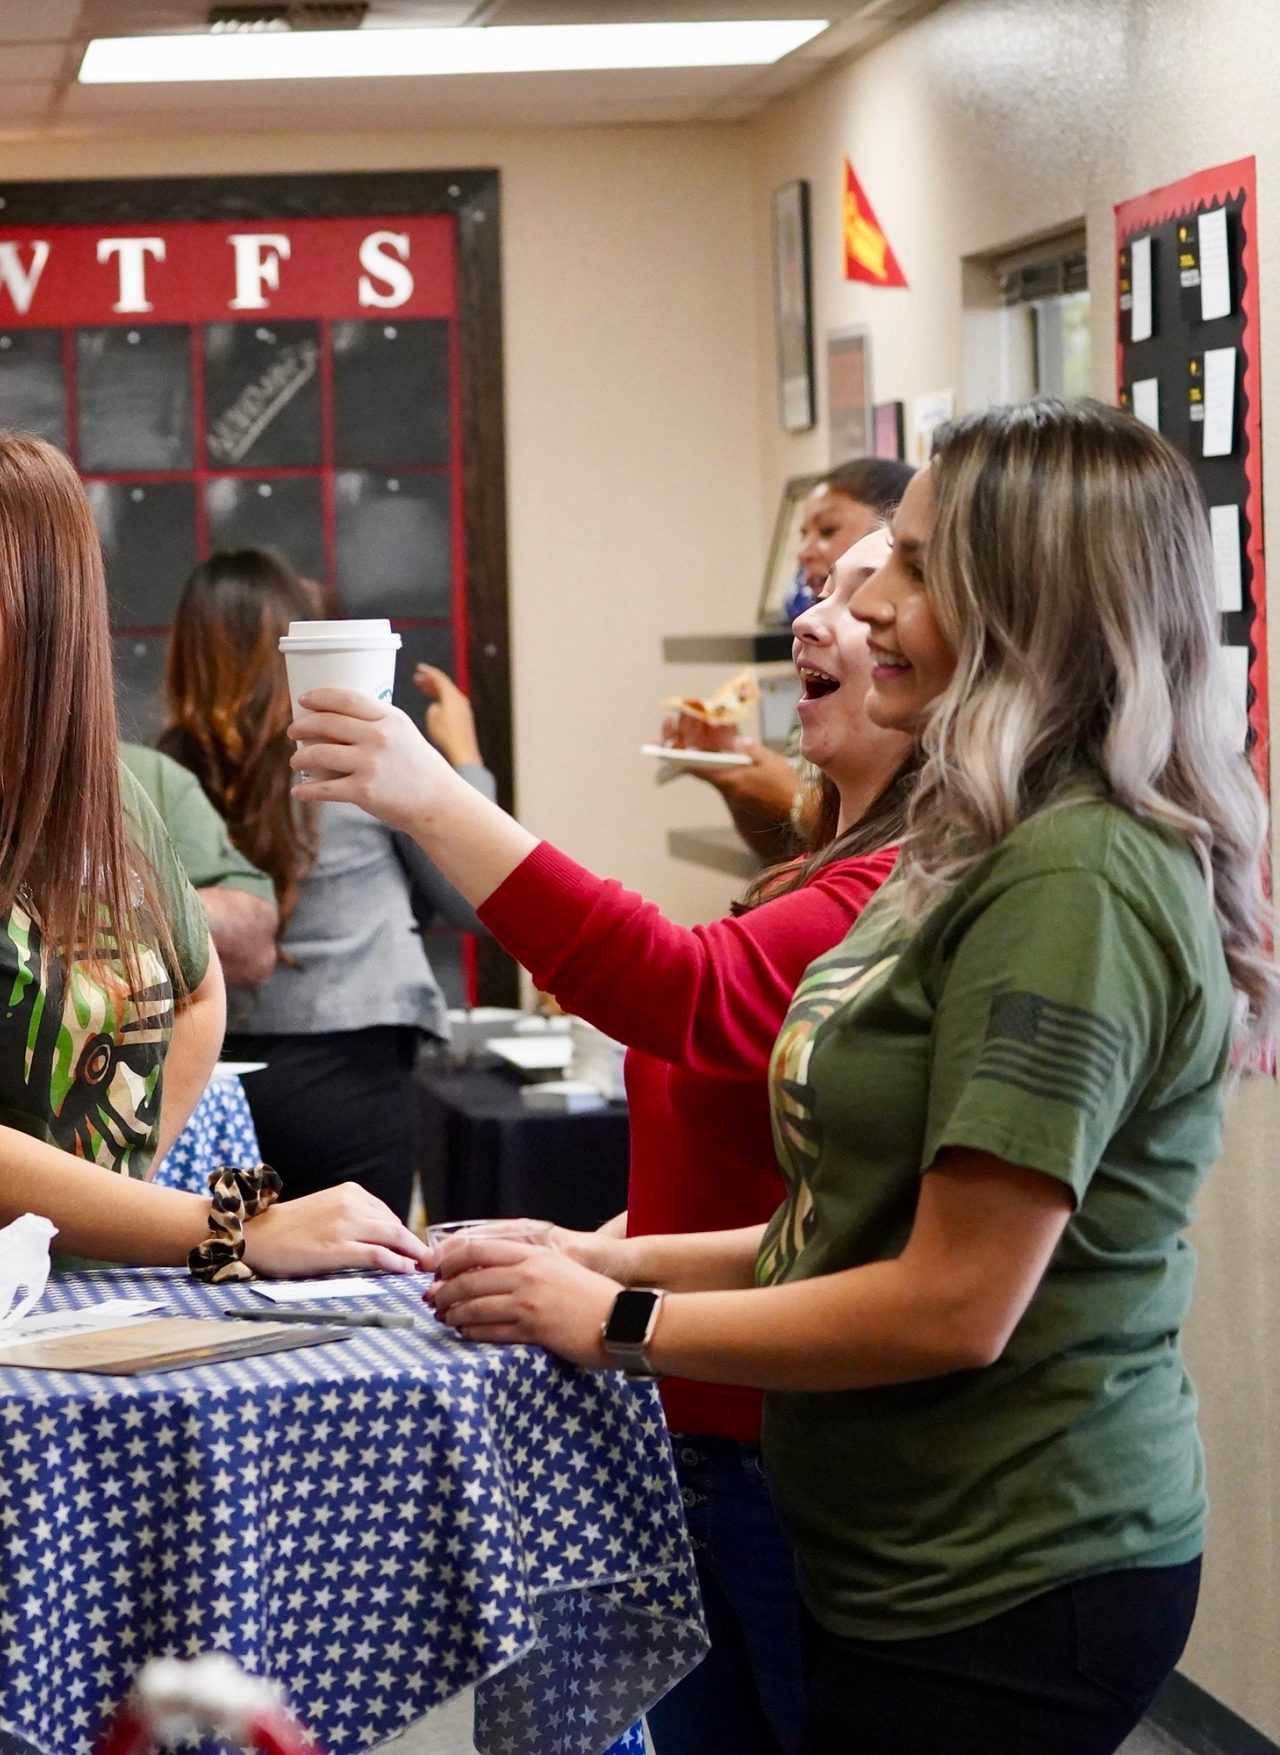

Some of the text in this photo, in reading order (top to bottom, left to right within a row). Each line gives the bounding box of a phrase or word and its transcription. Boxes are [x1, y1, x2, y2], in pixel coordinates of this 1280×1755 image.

[96, 236, 166, 313] T
[227, 233, 291, 310] F
[357, 231, 415, 309] S
